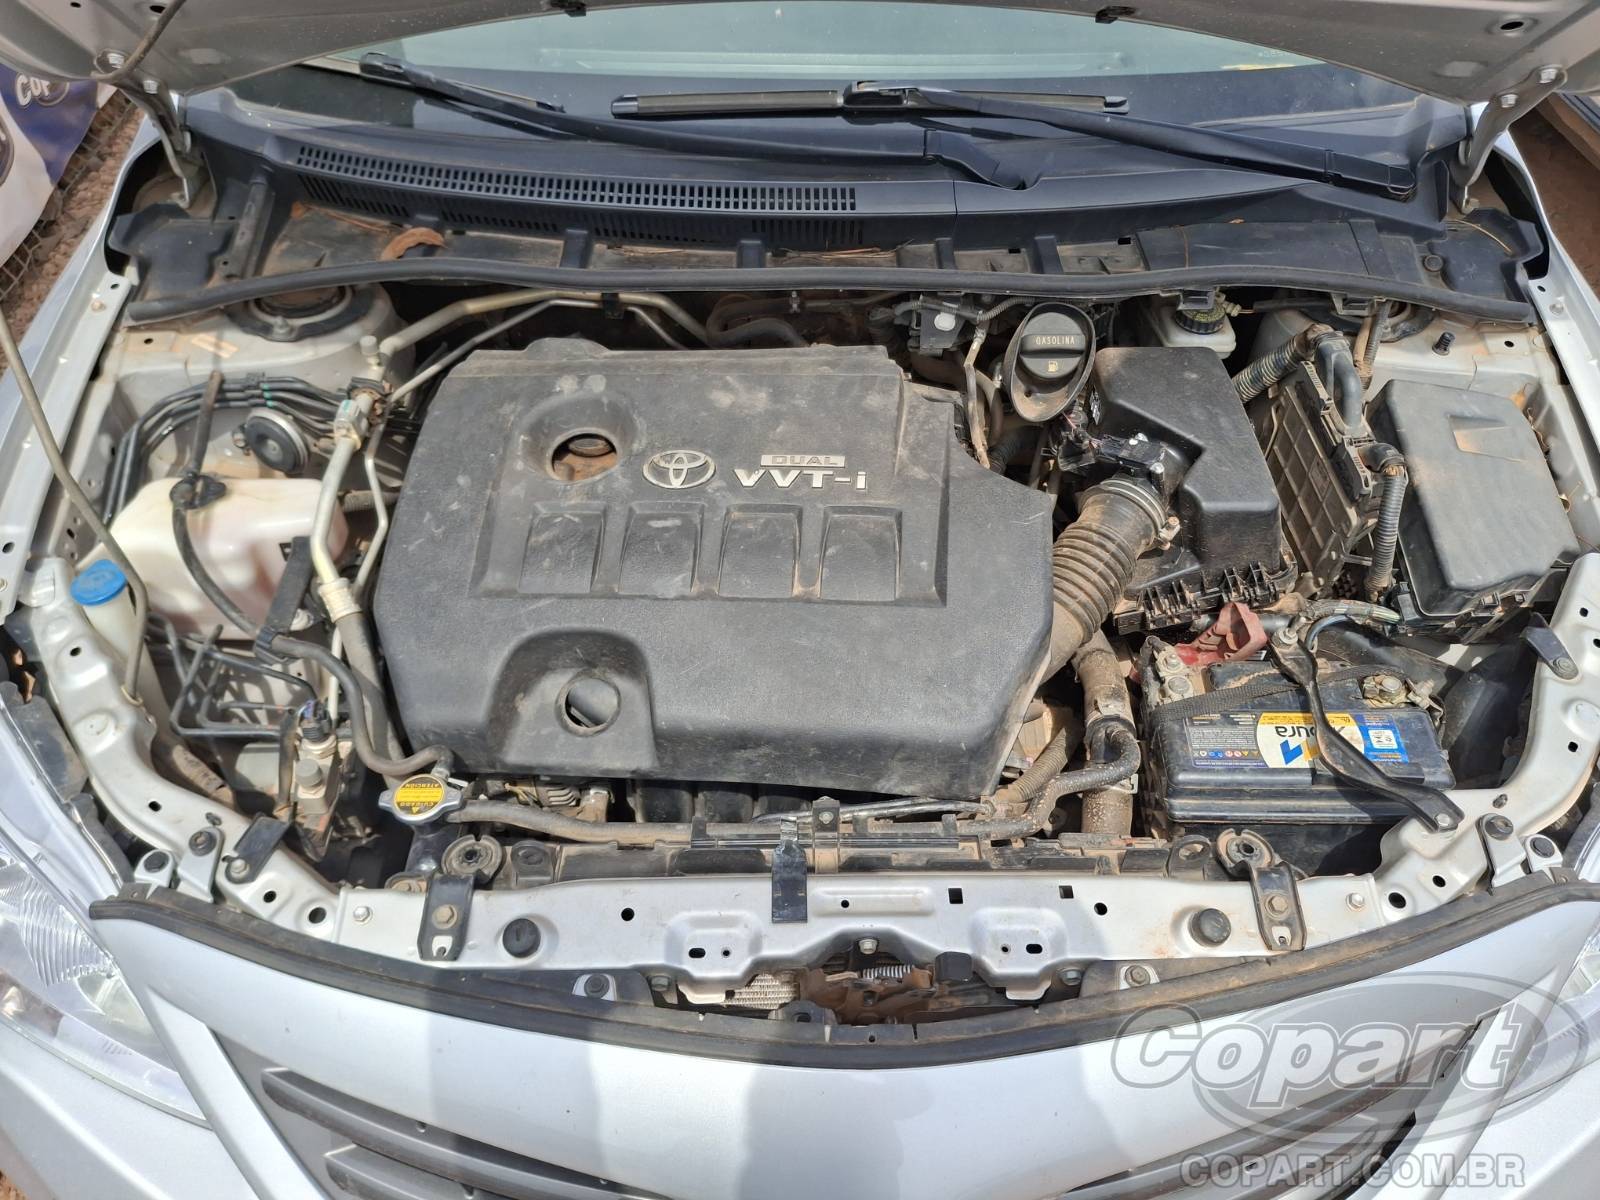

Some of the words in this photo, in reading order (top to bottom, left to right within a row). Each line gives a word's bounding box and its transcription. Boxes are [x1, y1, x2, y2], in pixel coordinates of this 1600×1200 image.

[1035, 336, 1075, 345] GASOLINA
[771, 455, 839, 466] DUAL
[733, 468, 868, 490] VVT-i
